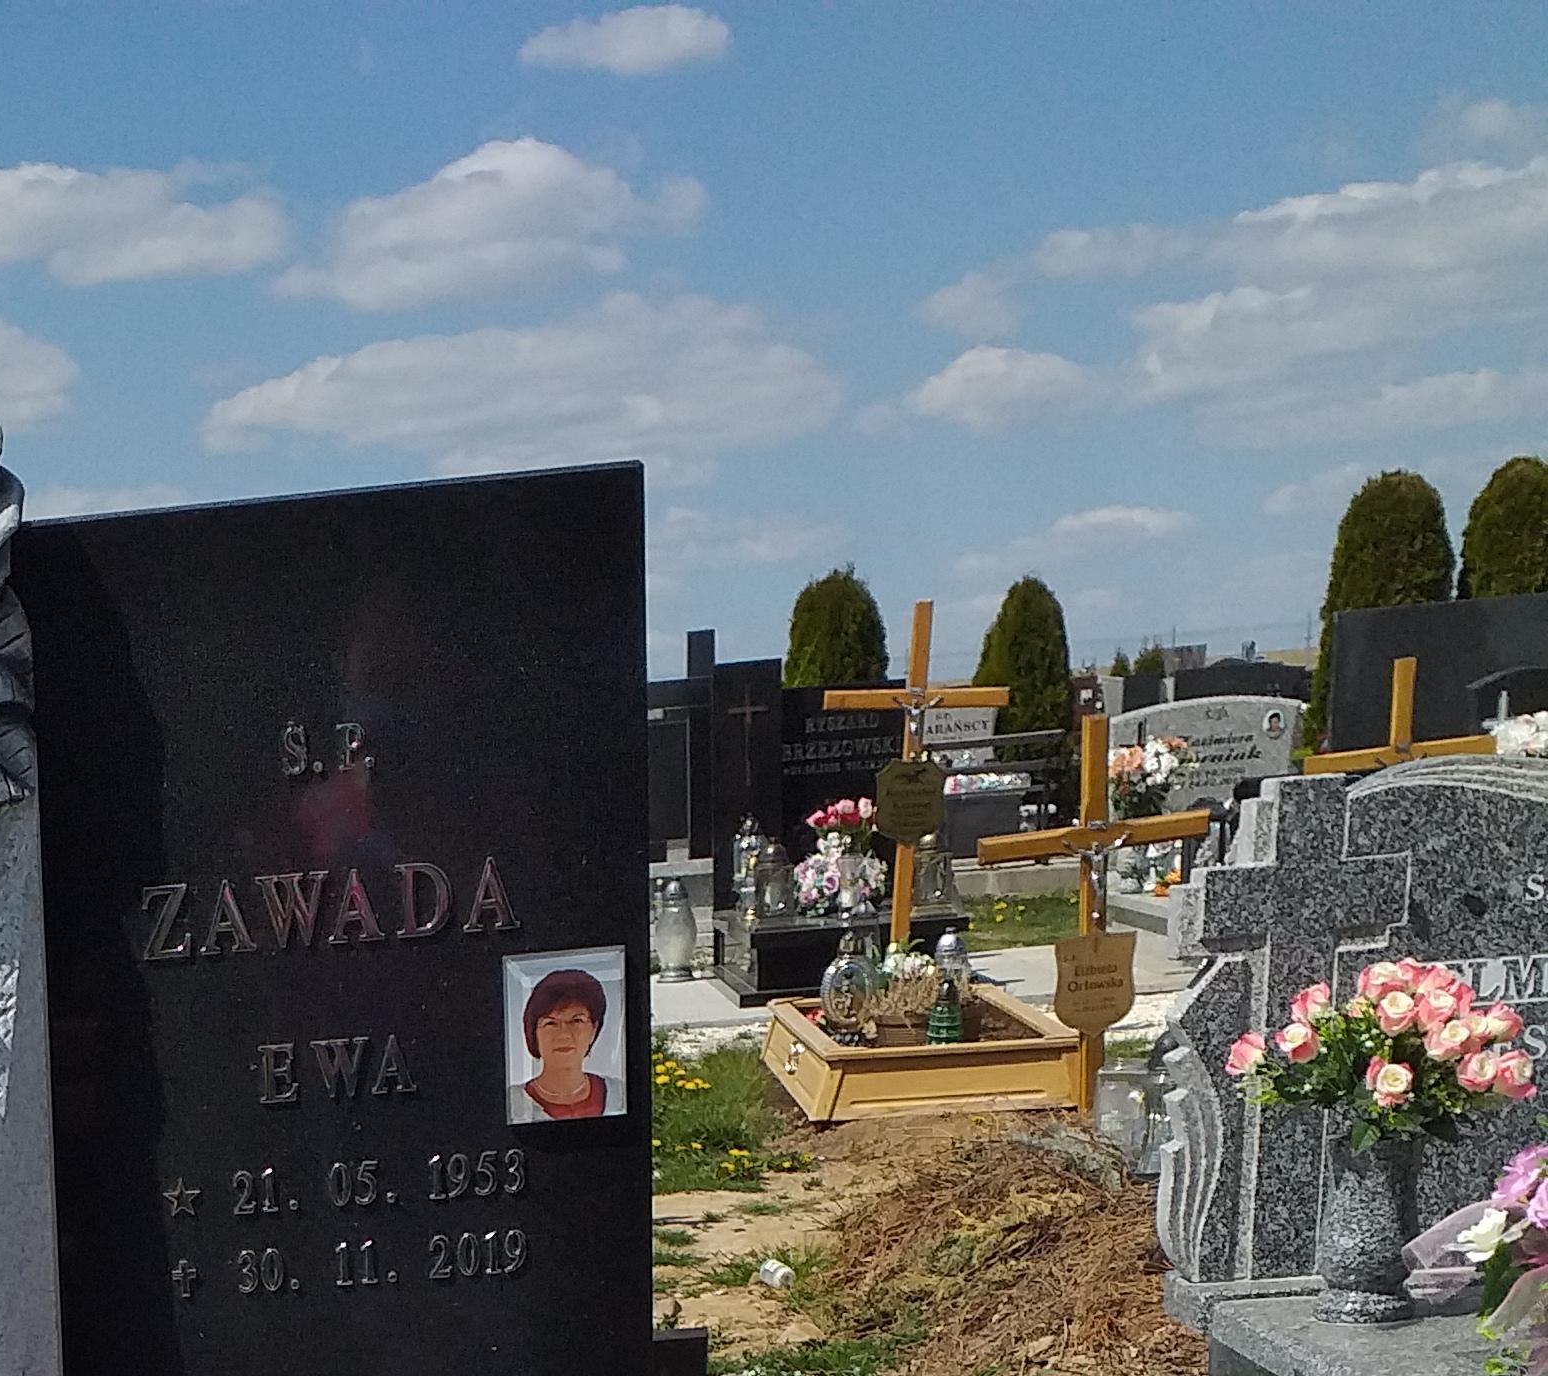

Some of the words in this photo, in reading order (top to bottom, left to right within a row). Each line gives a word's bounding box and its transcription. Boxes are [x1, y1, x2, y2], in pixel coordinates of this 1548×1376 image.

[142, 857, 521, 960] ZAWADA
[259, 1034, 417, 1105] EWA
[232, 1166, 300, 1215] 21.
[328, 1160, 397, 1206] 05.
[427, 1148, 526, 1201] 1953
[237, 1248, 301, 1293] 30.
[335, 1240, 398, 1287] 11.
[428, 1229, 527, 1279] 2019
